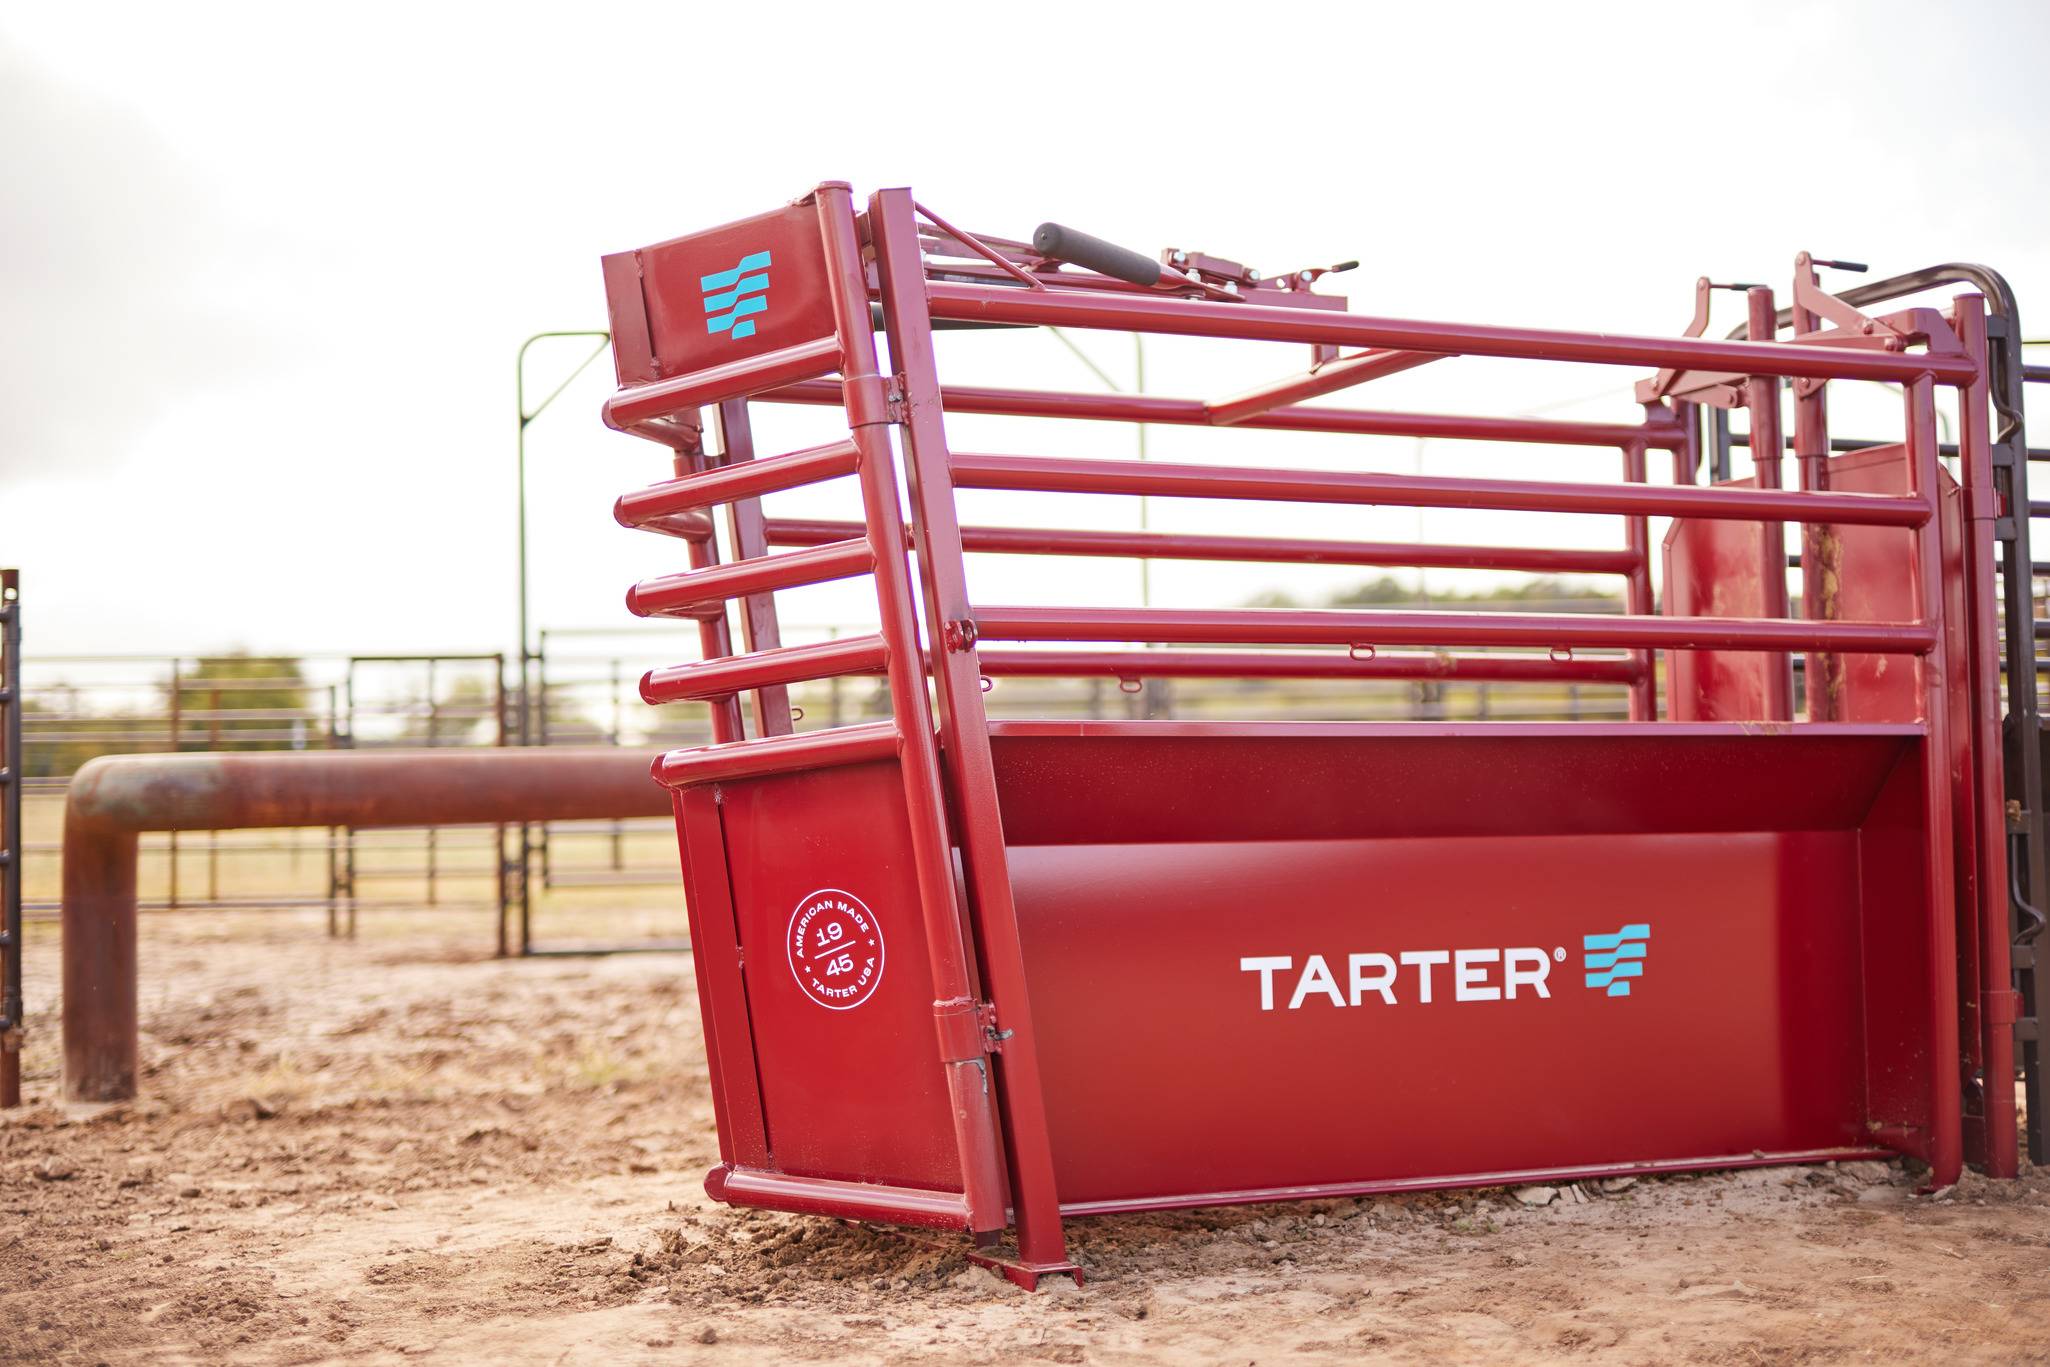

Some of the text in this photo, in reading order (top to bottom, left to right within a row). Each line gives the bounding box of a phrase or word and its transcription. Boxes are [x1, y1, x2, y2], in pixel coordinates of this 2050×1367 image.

[796, 900, 870, 959] AMERICAN MADE
[816, 922, 843, 947] 19
[811, 957, 875, 998] TARTER USA
[826, 953, 854, 976] 45
